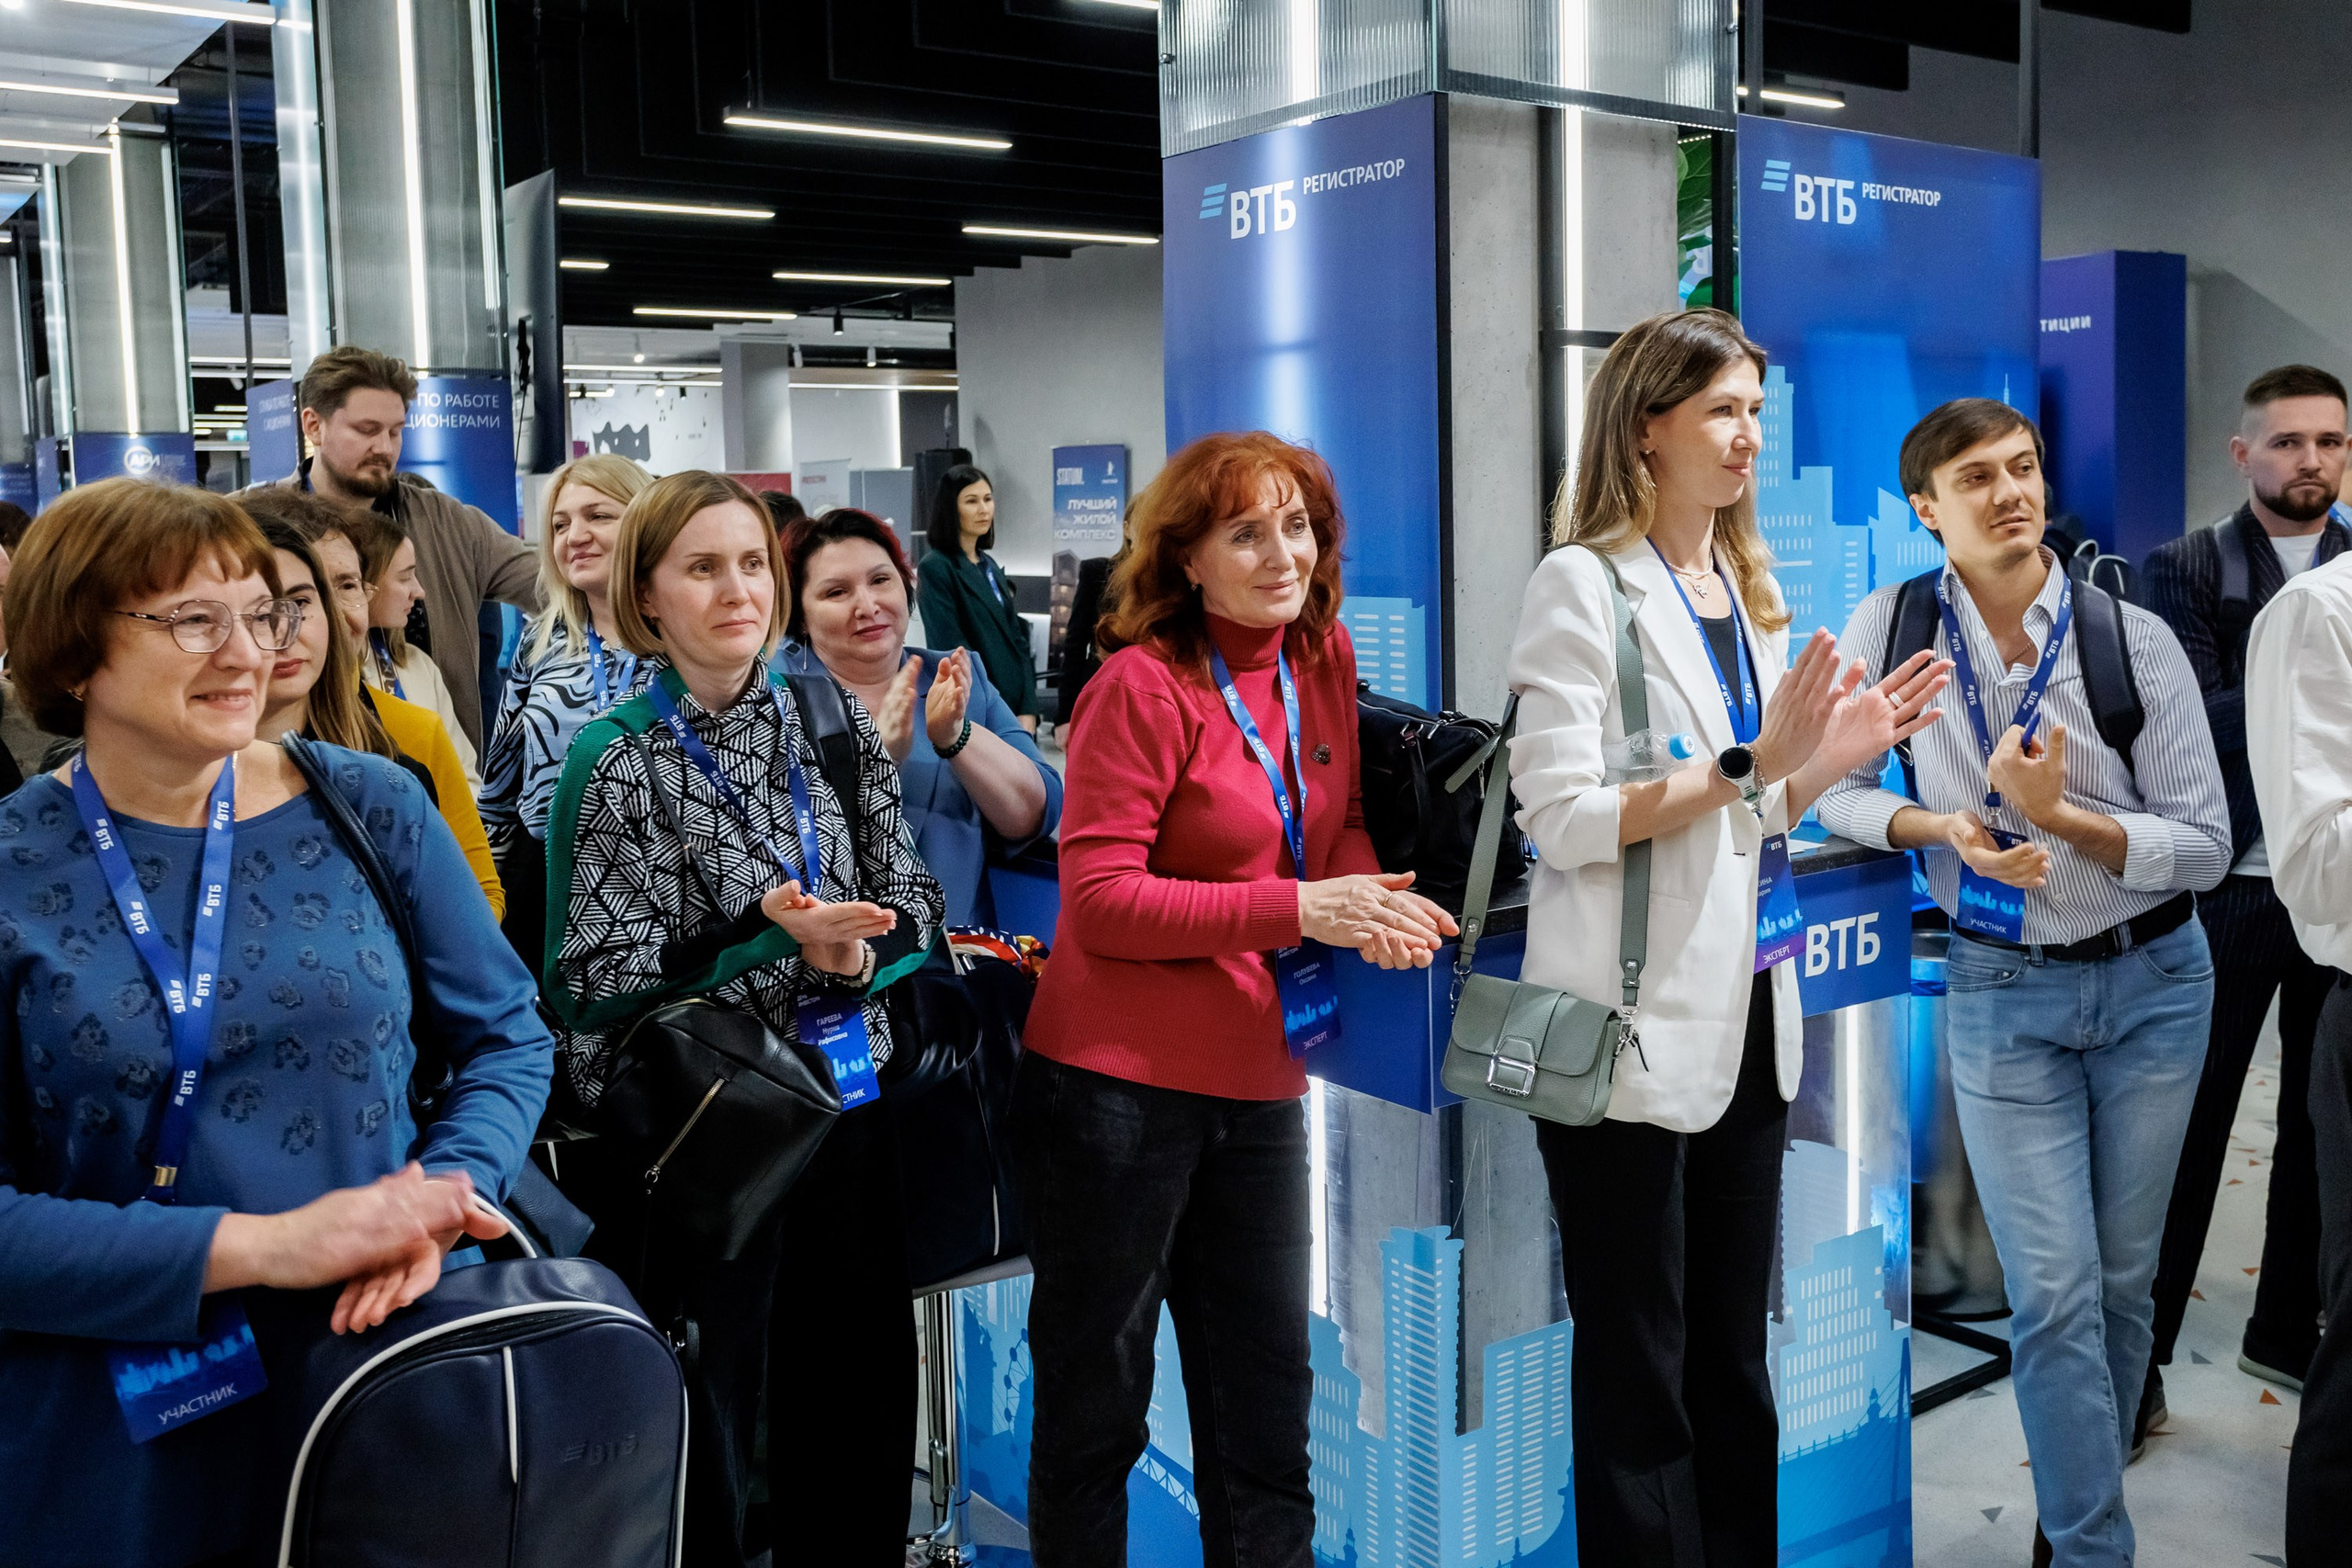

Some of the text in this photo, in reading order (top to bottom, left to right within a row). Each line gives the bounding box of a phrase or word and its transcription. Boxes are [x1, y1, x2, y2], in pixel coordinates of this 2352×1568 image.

[1230, 158, 1406, 240] ВТБ РЕГИСТРАТОР
[1794, 174, 1941, 225] ВТБ РЕГИСТРАТОР
[2040, 315, 2091, 333] тиции
[417, 392, 500, 409] ПО РАБОТЕ
[1068, 496, 1117, 510] ЛУЧШИЙ
[1073, 512, 1117, 525] ЖИЛОЙ
[1054, 529, 1116, 540] КОМПЛЕКС
[1952, 637, 1962, 652] ВТБ
[2051, 639, 2060, 655] ВТБ
[1225, 684, 1237, 701] ВТБ
[1284, 685, 1294, 700] ВТБ
[1745, 682, 1753, 698] ВТБ
[2027, 691, 2039, 705] ВТБ
[1722, 691, 1733, 707] ВТБ
[1967, 691, 1977, 706] ВТБ
[669, 715, 685, 731] ВТБ
[1252, 739, 1265, 753] ВТБ
[710, 770, 723, 787] ВТБ
[217, 801, 230, 821] ВТБ
[1279, 795, 1290, 812] ВТБ
[800, 818, 811, 834] ВТБ
[95, 828, 114, 851] ВТБ
[1770, 840, 1782, 851] ВТБ
[207, 885, 221, 907] ВТБ
[130, 911, 150, 935] ВТБ
[1970, 918, 2007, 934] УЧАСТНИК
[1804, 912, 1882, 978] ВТБ
[1763, 945, 1791, 964] ЭКСПЕРТ
[1294, 962, 1321, 978] ГОЛУБЕВА
[196, 973, 211, 997] ВТБ
[1299, 974, 1317, 986] Оксана
[169, 989, 187, 1014] ВТБ
[816, 1012, 843, 1027] ГАРЕЕВА
[1303, 1031, 1328, 1051] ЭКСПЕРТ
[179, 1070, 197, 1095] ВТБ
[158, 1382, 238, 1425] УЧАСТНИК
